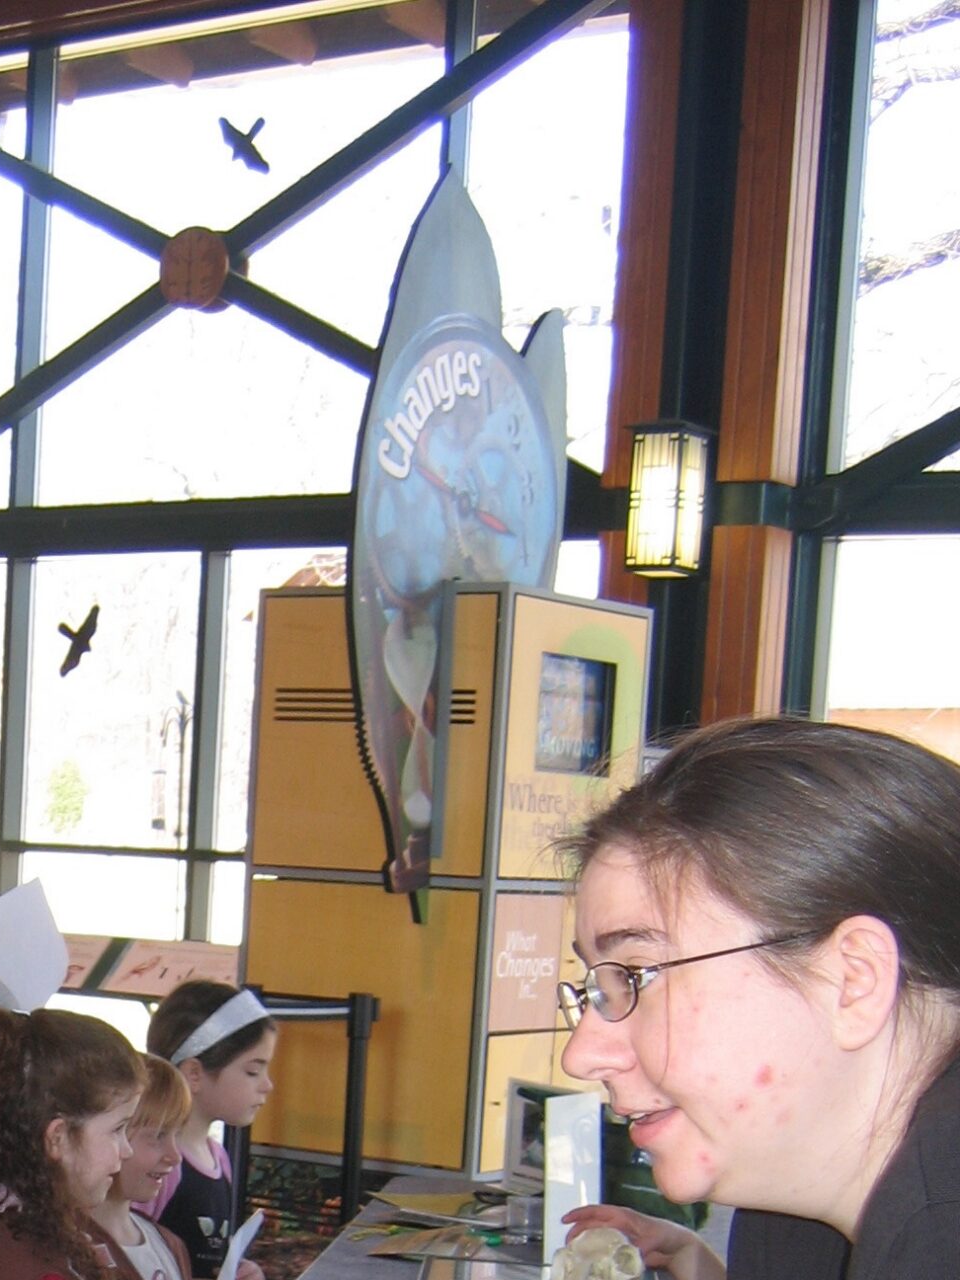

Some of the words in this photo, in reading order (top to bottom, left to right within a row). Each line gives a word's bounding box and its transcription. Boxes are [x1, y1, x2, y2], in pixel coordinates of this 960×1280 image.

[378, 350, 482, 480] Changes
[505, 930, 538, 952] What
[496, 951, 556, 984] Changes
